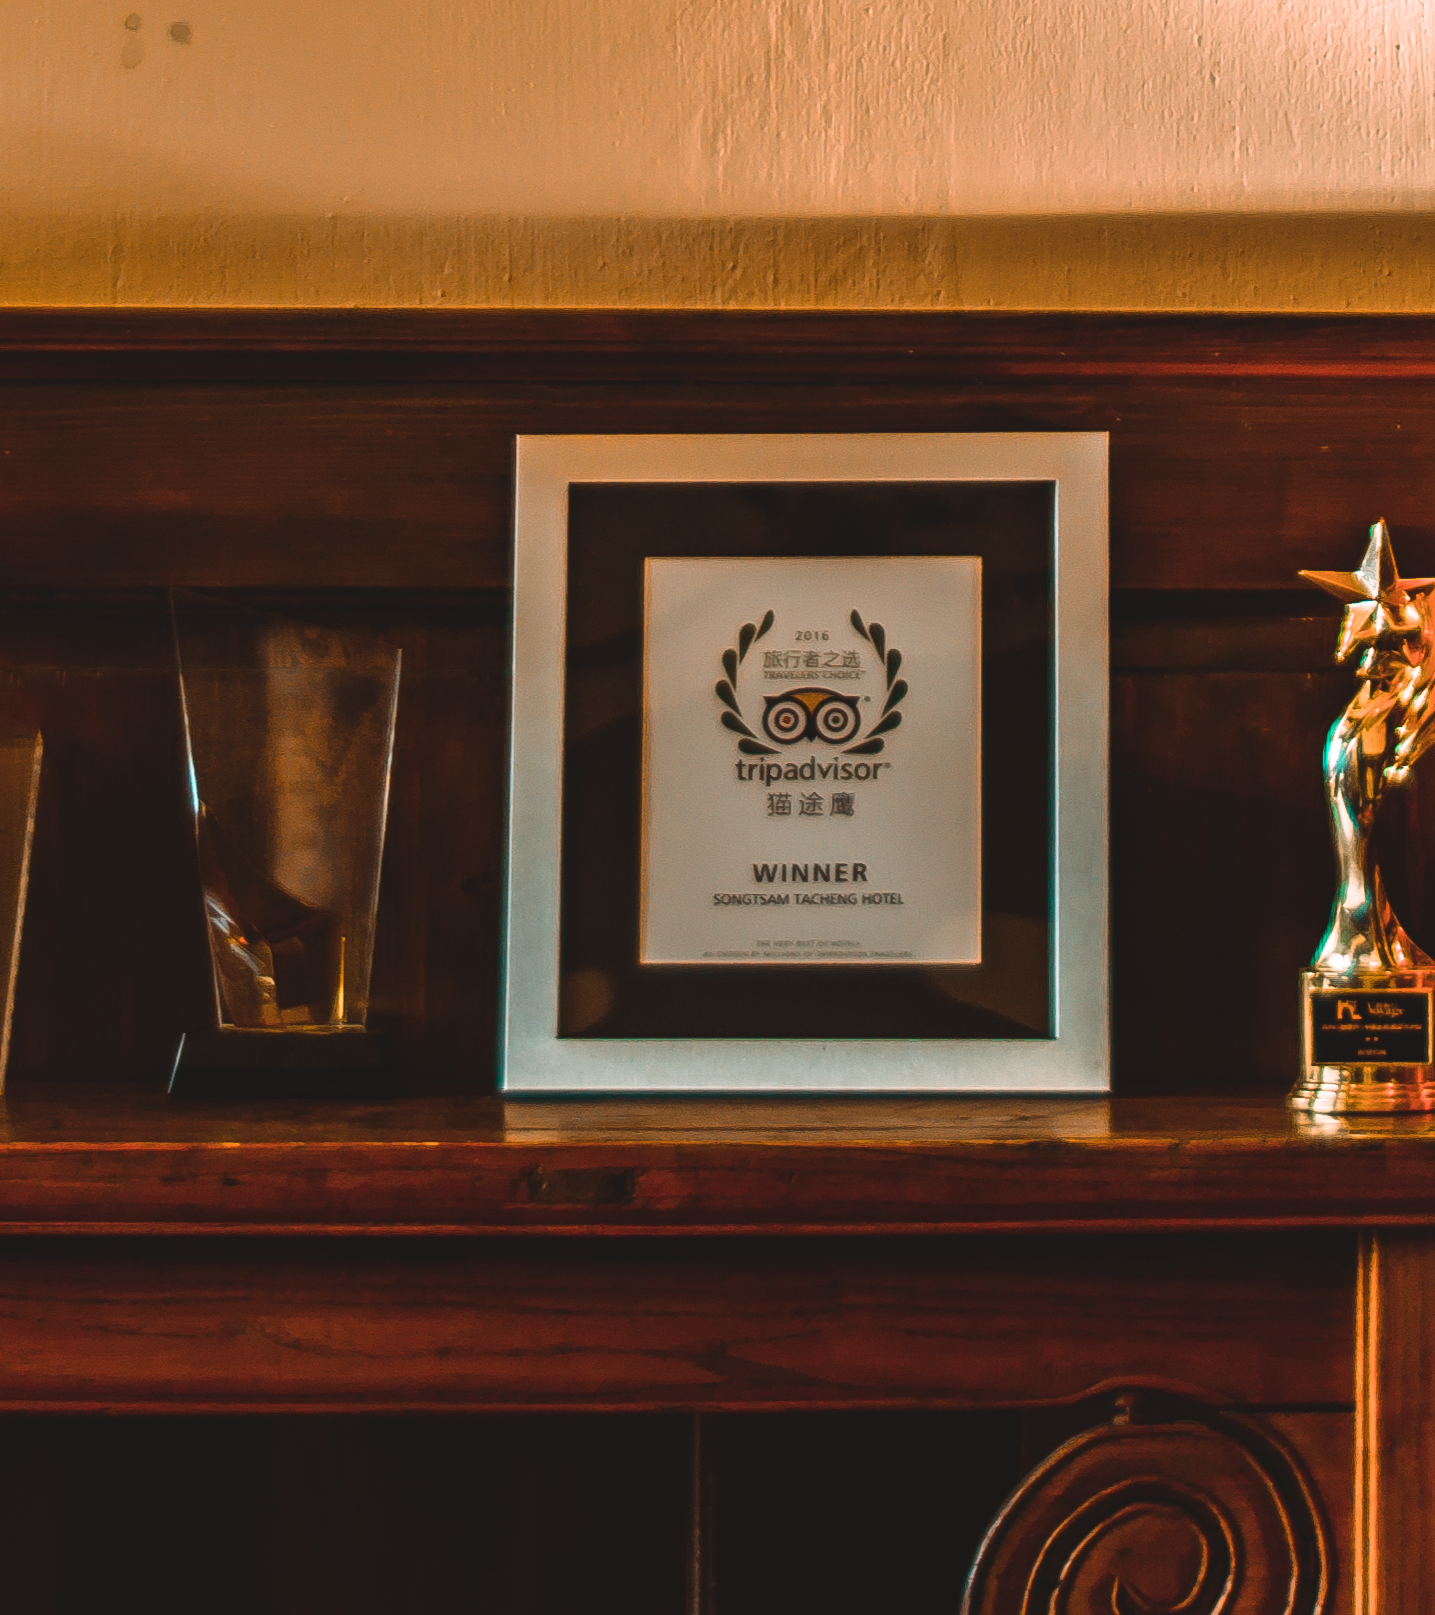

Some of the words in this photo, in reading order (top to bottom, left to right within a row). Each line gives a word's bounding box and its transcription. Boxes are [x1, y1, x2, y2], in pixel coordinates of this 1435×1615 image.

[795, 630, 830, 641] 2016
[763, 649, 861, 669] 旅行者之选
[735, 756, 883, 787] tripadvisor
[766, 791, 856, 817] 猫途鹰
[752, 862, 869, 883] WINNER
[712, 892, 790, 906] SONGTSAM
[794, 892, 859, 906] TACHENG
[861, 892, 905, 906] HOTEL
